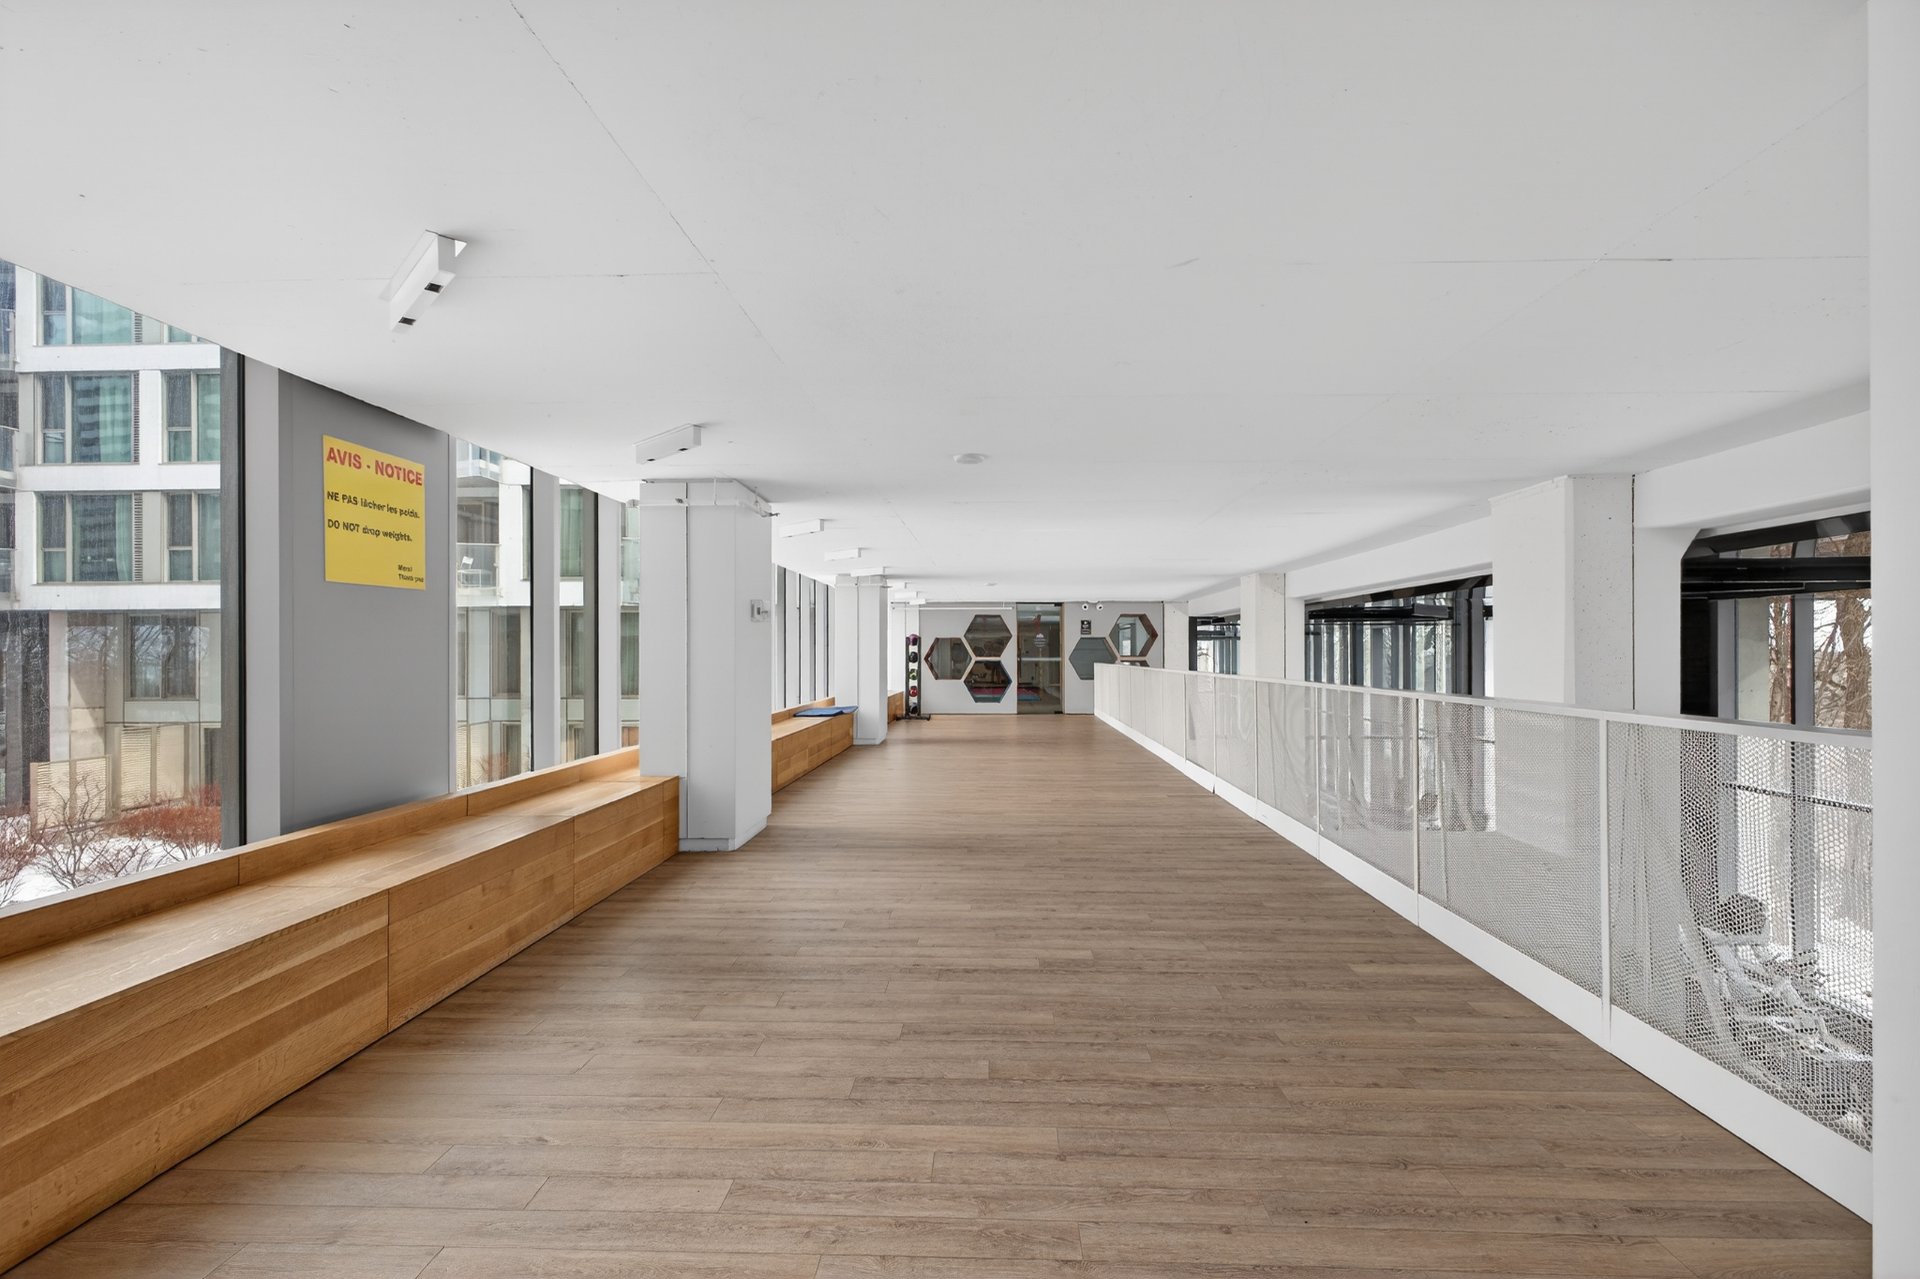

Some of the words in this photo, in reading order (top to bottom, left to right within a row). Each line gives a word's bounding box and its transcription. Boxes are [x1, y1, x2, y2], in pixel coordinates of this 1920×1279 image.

[326, 447, 362, 470] AVIS
[375, 459, 423, 486] NOTICE
[327, 490, 340, 502] NE
[341, 493, 358, 506] PAS
[386, 503, 398, 515] les
[327, 519, 340, 529] DO
[342, 521, 360, 533] NOT
[362, 525, 380, 538] drop
[382, 530, 413, 542] weights.
